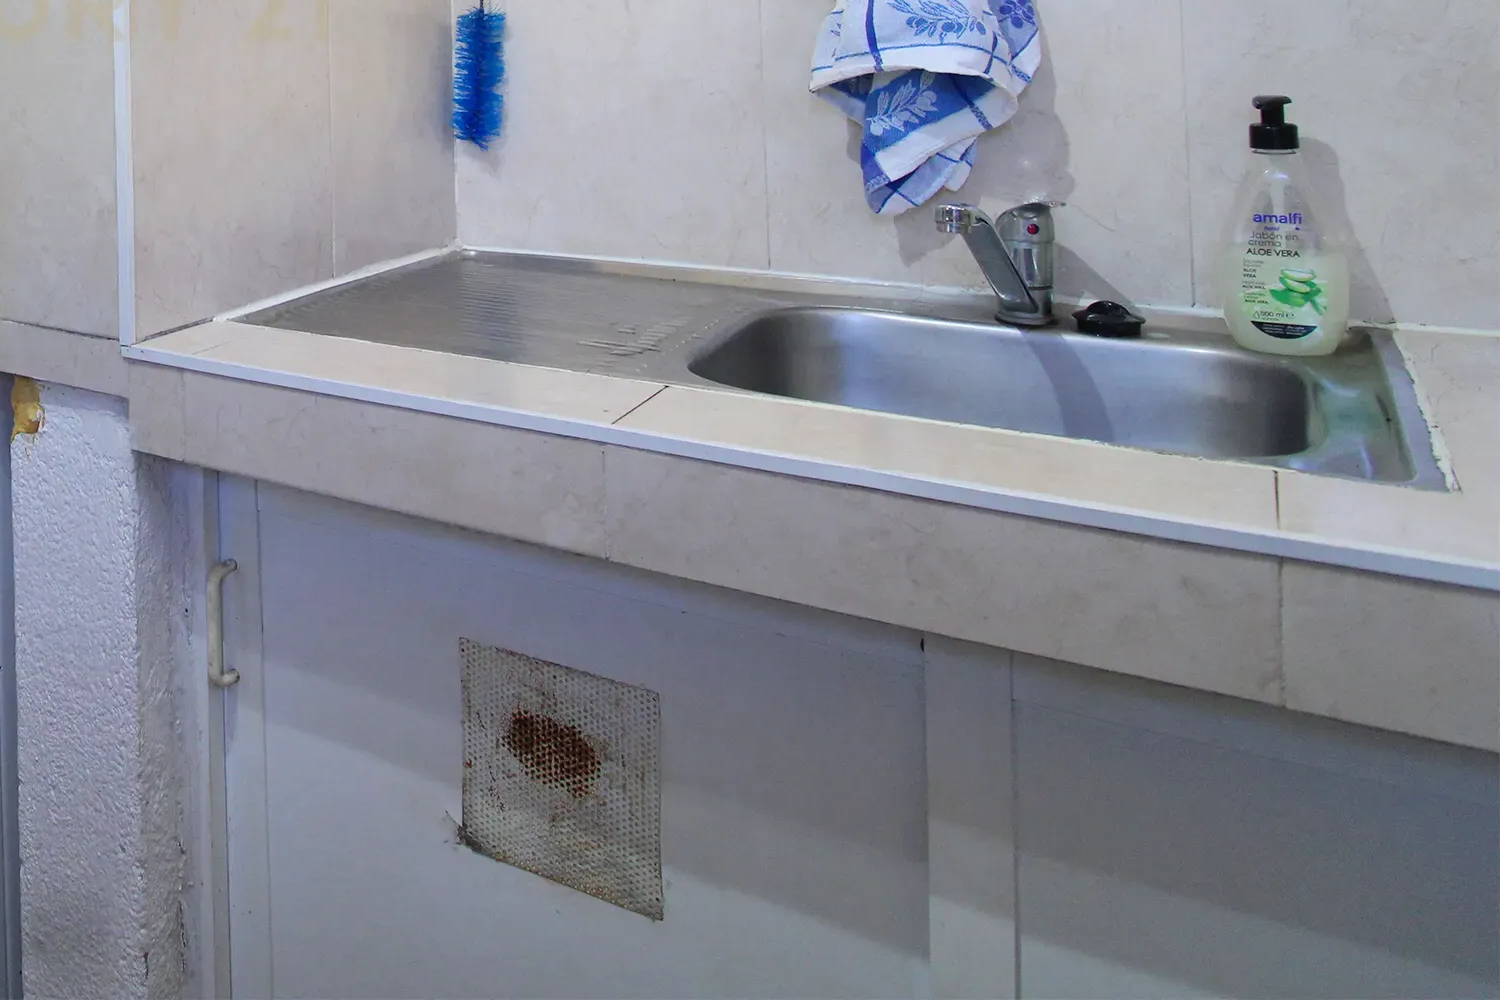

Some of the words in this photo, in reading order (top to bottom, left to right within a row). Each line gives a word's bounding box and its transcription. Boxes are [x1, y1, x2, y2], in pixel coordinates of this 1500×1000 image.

[1252, 212, 1303, 225] amalfi
[1250, 231, 1283, 241] Jabón
[1248, 240, 1282, 248] crema
[1246, 247, 1273, 257] ALOE
[1274, 249, 1301, 258] VERA
